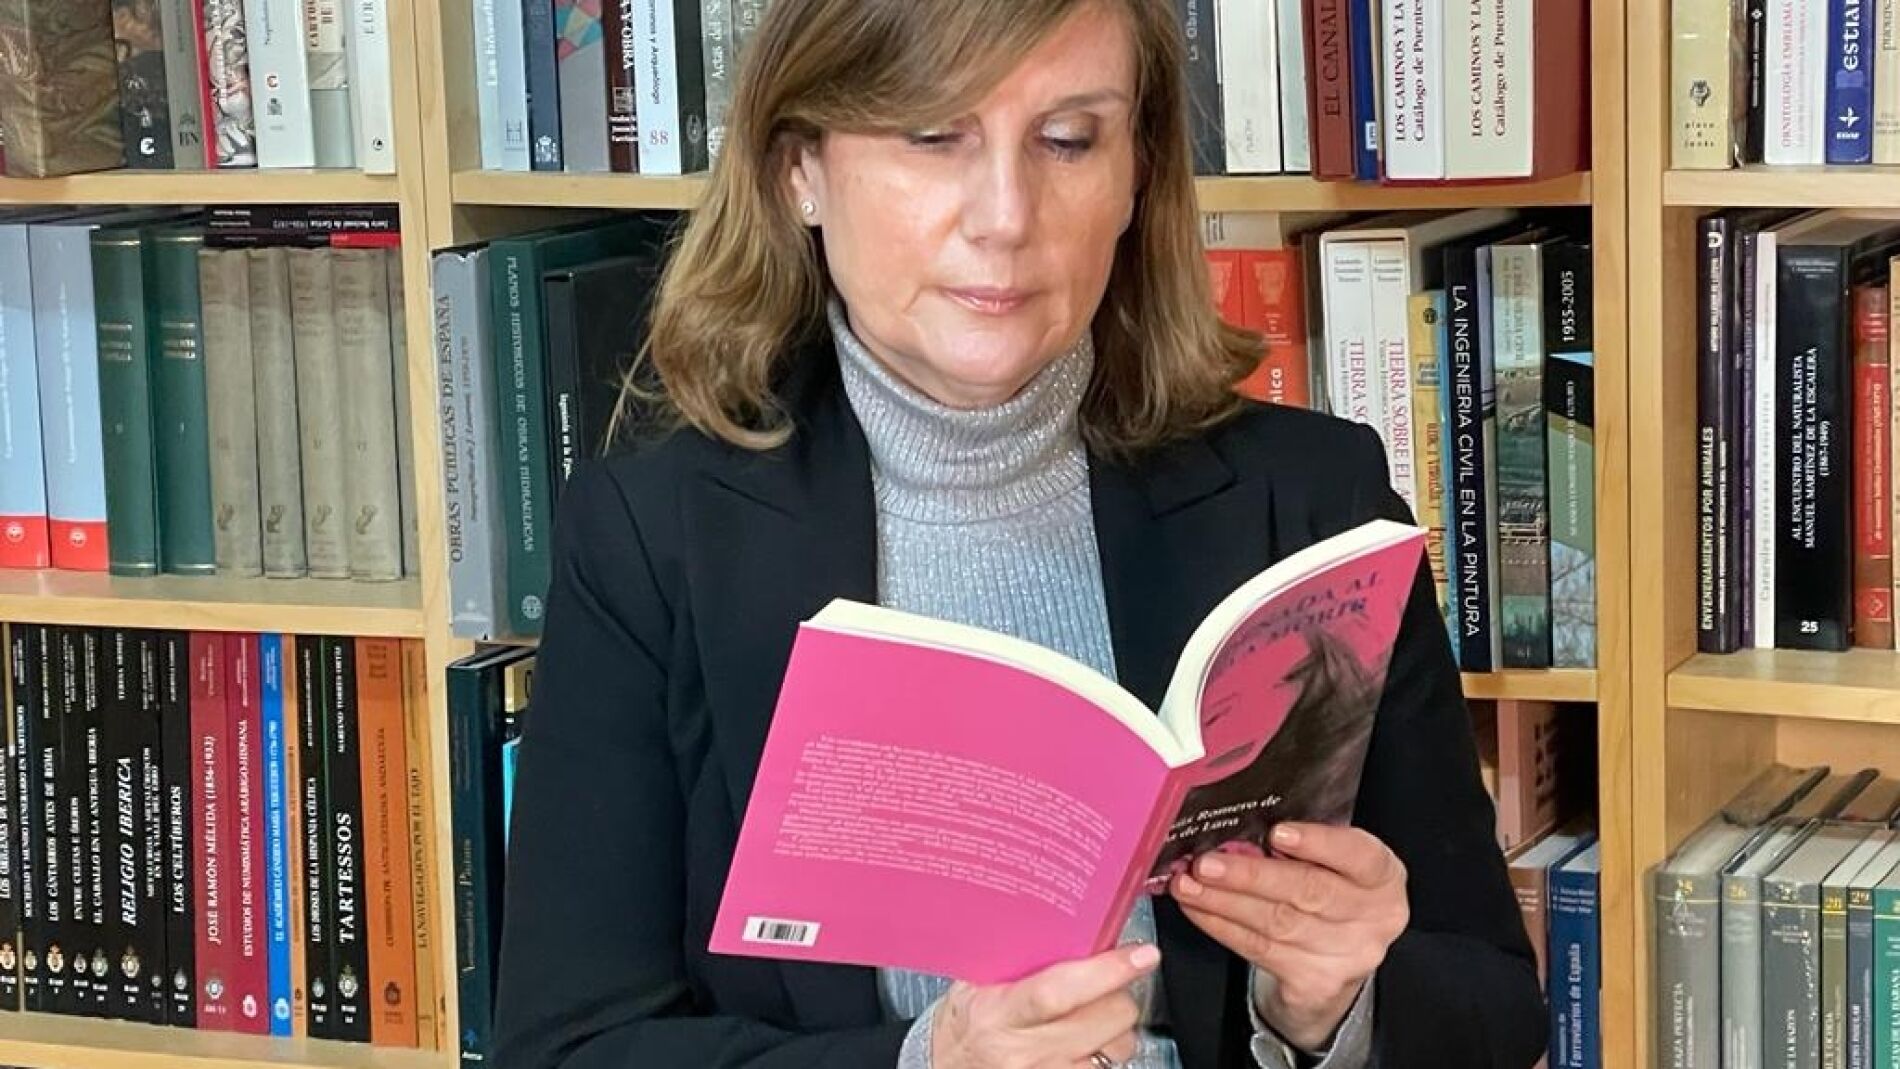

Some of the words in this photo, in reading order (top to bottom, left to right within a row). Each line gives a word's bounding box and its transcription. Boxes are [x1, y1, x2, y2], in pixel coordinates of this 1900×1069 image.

[1393, 2, 1404, 20] LA
[1469, 19, 1481, 31] Y
[1321, 0, 1339, 82] CANAL
[1393, 24, 1405, 36] Y
[1393, 41, 1406, 109] CAMINOS
[1412, 57, 1424, 75] de
[1470, 36, 1483, 105] CAMINOS
[1493, 51, 1504, 69] de
[1324, 90, 1340, 117] EL
[1412, 79, 1427, 142] Catálogo
[1493, 72, 1507, 137] Catálogo
[650, 130, 669, 145] 88
[1393, 113, 1405, 142] LOS
[1470, 108, 1482, 137] LOS
[507, 256, 521, 308] PLANOS
[1451, 285, 1466, 312] LA
[1561, 271, 1576, 343] 1955-2005
[434, 294, 452, 365] ESPAÑA
[440, 369, 454, 399] DE
[1349, 336, 1367, 401] TIERRA
[1388, 336, 1406, 401] TIERRA
[1453, 318, 1474, 428] INGENIERIA
[1806, 347, 1818, 404] ESCALERA
[515, 394, 527, 413] DE
[1792, 355, 1804, 430] NATURALISTA
[1806, 406, 1817, 422] LA
[517, 416, 531, 462] OBRAS
[1392, 405, 1410, 459] SOBRE
[1792, 431, 1803, 454] DEL
[1806, 425, 1817, 441] DE
[1458, 433, 1475, 483] CIVIL
[1702, 426, 1714, 487] ANIMALES
[1804, 443, 1817, 500] MARTÍNEZ
[1394, 462, 1411, 487] EL
[1791, 456, 1803, 523] ENCUENTRO
[1461, 488, 1475, 515] EN
[1702, 488, 1713, 513] POR
[448, 501, 463, 563] OBRAS
[1462, 520, 1477, 547] LA
[1791, 524, 1802, 541] AL
[1805, 502, 1816, 549] MANUEL
[1701, 515, 1714, 630] ENVENENAMIENTOS
[1463, 552, 1480, 637] PINTURA
[1800, 619, 1819, 633] 25
[87, 726, 98, 765] IBERIA
[18, 757, 27, 771] EN
[43, 746, 55, 779] ROMA
[44, 781, 55, 797] DE
[88, 767, 100, 817] ANTIGUA
[116, 756, 134, 837] IBERICA
[151, 794, 160, 814] DEL
[44, 800, 57, 833] ANTES
[1196, 800, 1258, 822] Romero
[1261, 794, 1282, 808] de
[90, 819, 100, 834] LA
[152, 817, 161, 847] VALLE
[168, 784, 184, 881] CELTÍBEROS
[203, 802, 217, 854] MÉLIDA
[1179, 825, 1200, 839] de
[1202, 817, 1239, 833] Lara
[91, 837, 101, 853] EN
[153, 849, 161, 862] EL
[239, 816, 252, 888] NUMISMÁTICA
[45, 836, 59, 897] CÁNTABROS
[71, 844, 83, 884] CELTAS
[91, 854, 103, 907] CABALLO
[153, 864, 162, 879] EN
[308, 861, 320, 874] LA
[335, 811, 355, 943] TARTESSOS
[118, 842, 137, 927] RELIGIO
[173, 882, 185, 912] LOS
[204, 856, 218, 907] RAMÓN
[241, 890, 252, 905] DE
[309, 875, 320, 889] DE
[47, 900, 59, 922] LOS
[72, 885, 83, 920] ENTRE
[92, 908, 103, 924] EL
[205, 910, 222, 946] JOSÉ
[242, 906, 253, 957] ESTUDIOS
[311, 923, 322, 942] LOS
[1567, 943, 1583, 983] España
[1569, 985, 1582, 999] de
[1569, 1002, 1583, 1068] Ferroviarios
